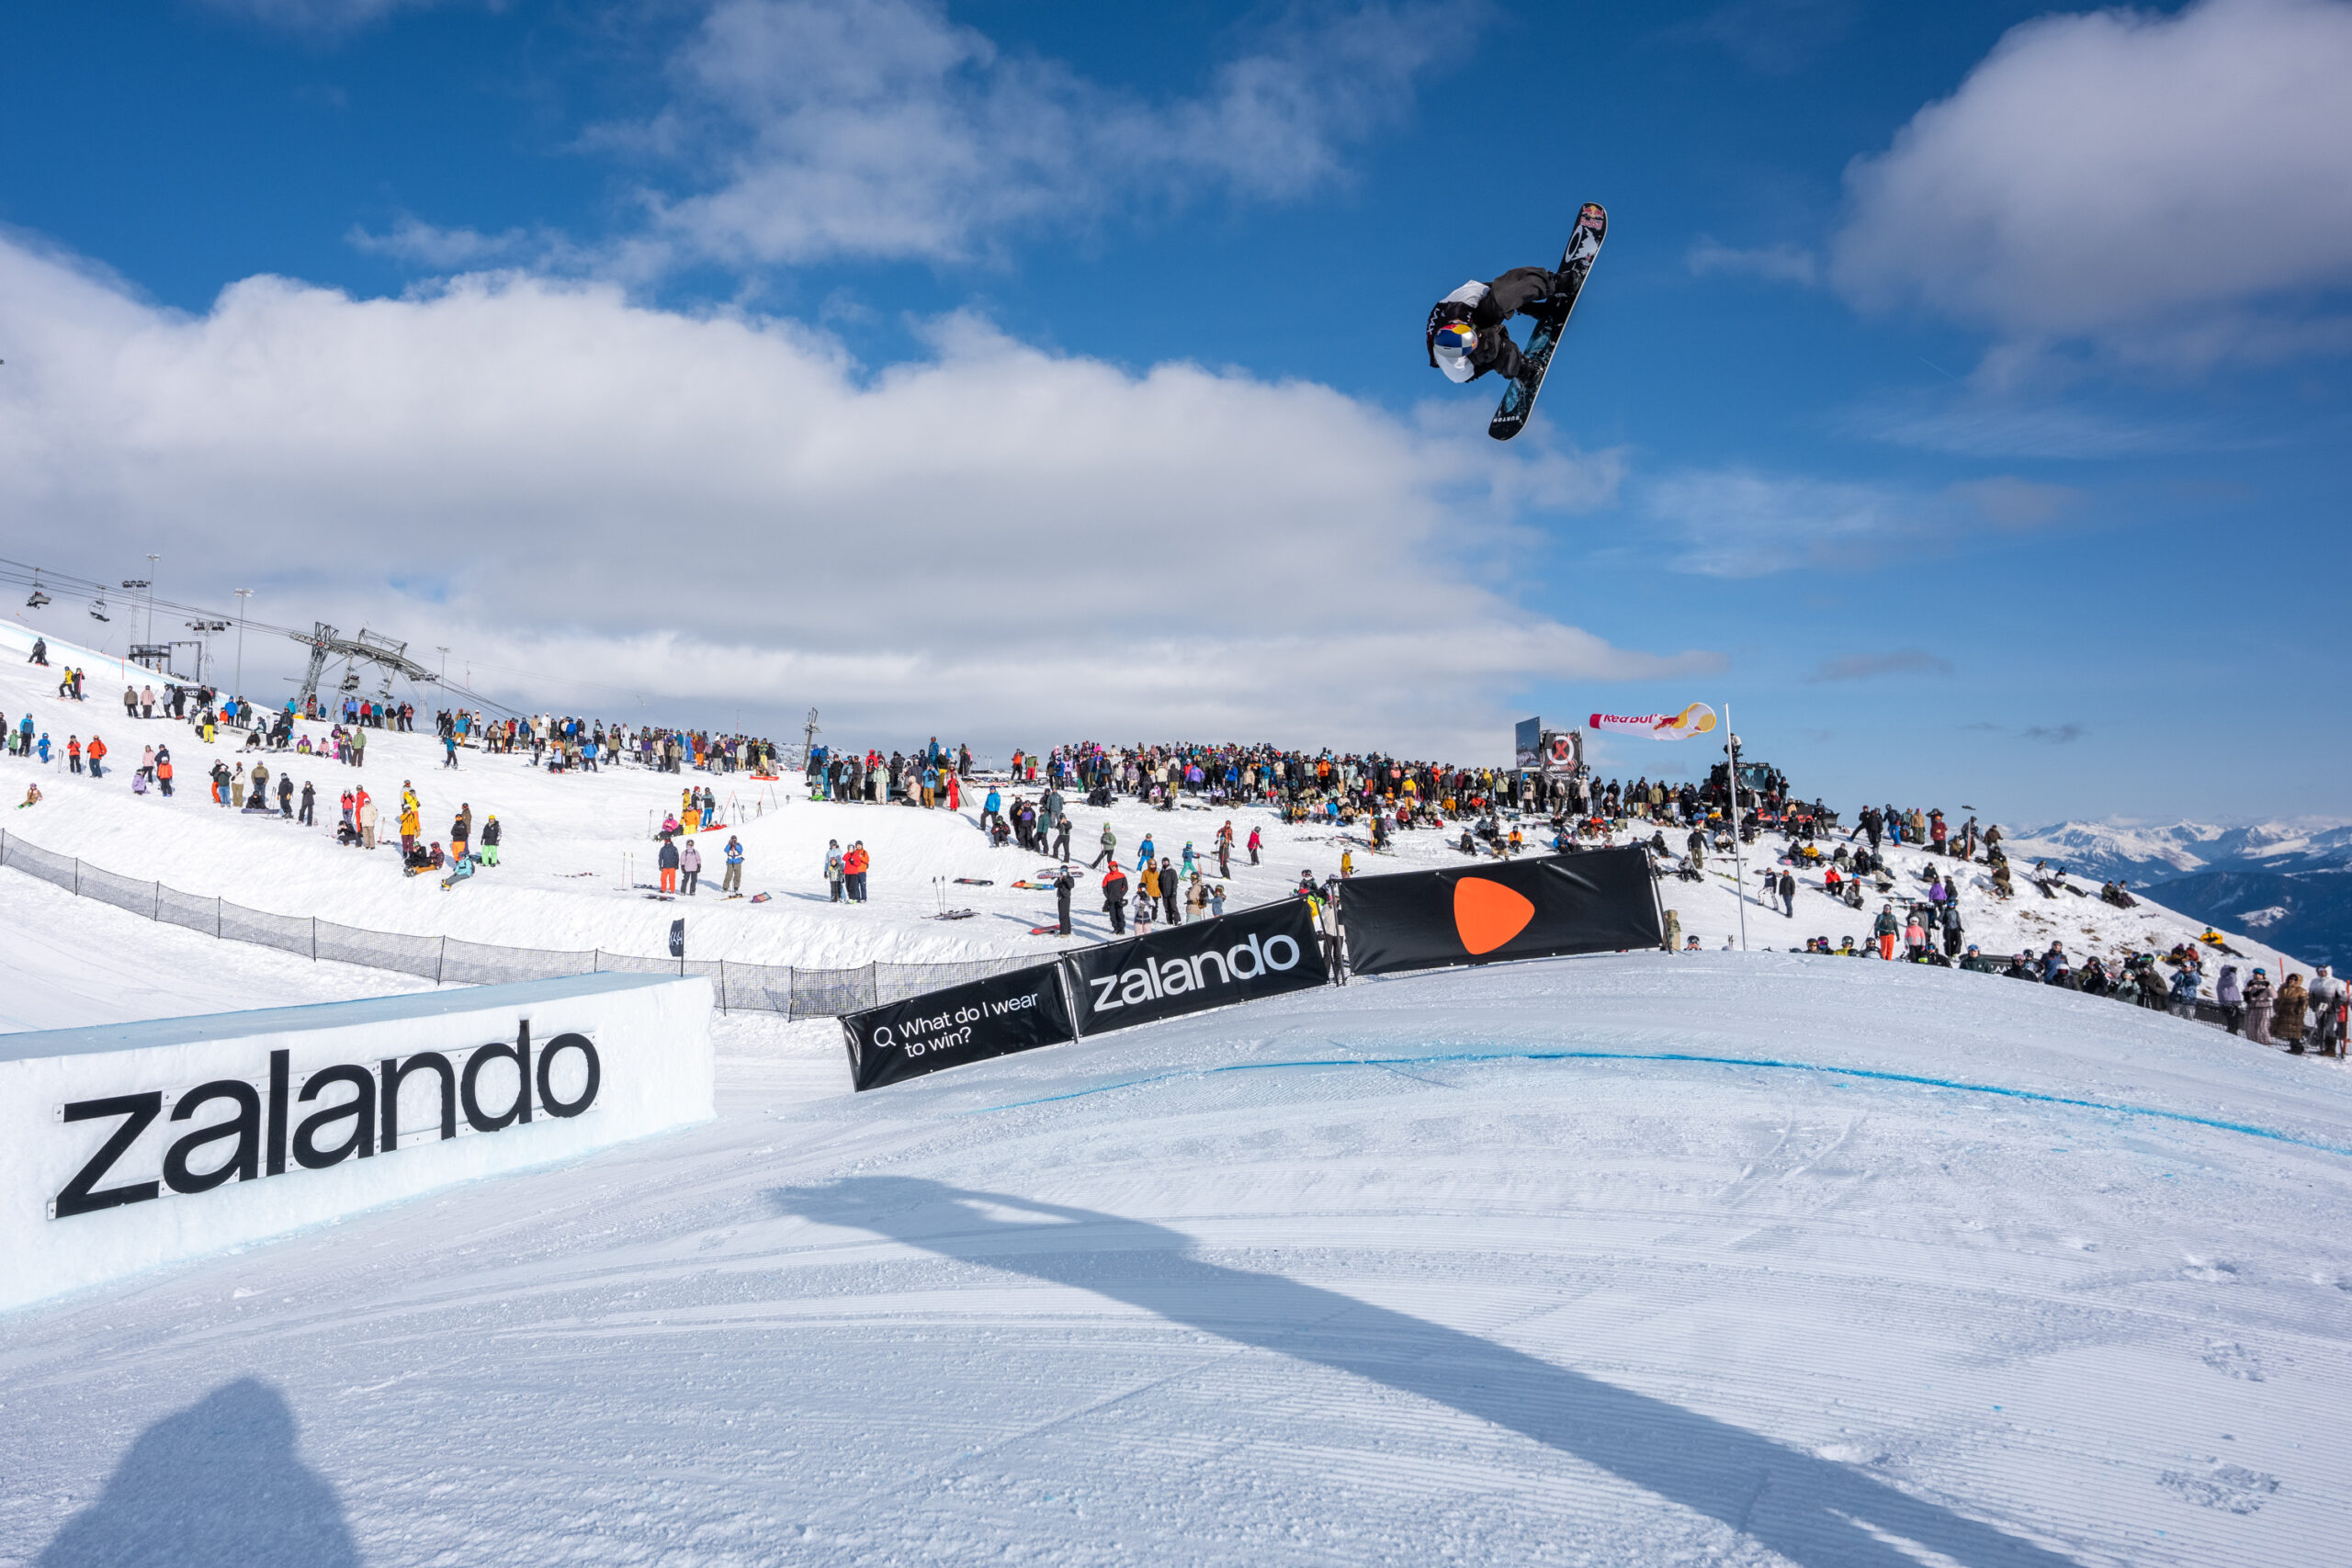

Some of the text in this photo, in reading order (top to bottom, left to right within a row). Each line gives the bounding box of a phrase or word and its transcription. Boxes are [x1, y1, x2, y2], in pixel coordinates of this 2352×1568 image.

[1090, 932, 1300, 1012] zalando
[899, 993, 1038, 1038] What do I wear
[904, 1026, 972, 1057] to win?
[54, 1020, 601, 1220] zalando
